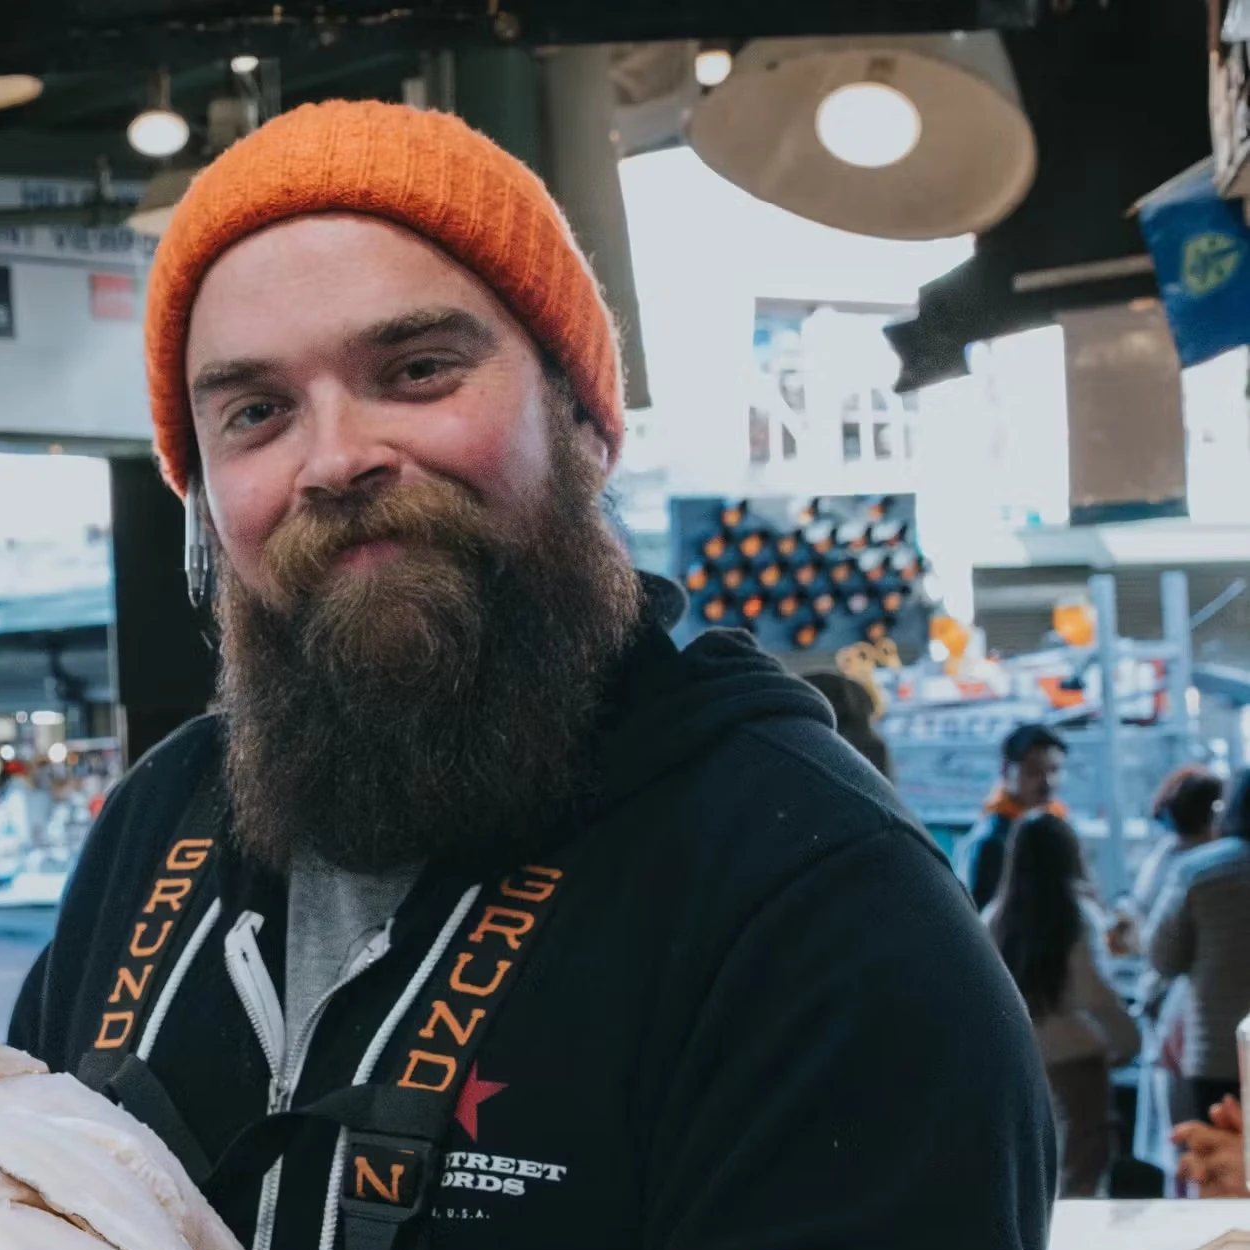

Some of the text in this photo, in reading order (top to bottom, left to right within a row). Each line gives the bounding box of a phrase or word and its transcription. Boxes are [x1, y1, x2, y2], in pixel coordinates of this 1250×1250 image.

[94, 838, 214, 1049] GRUND
[397, 864, 563, 1092] GRUND
[445, 1151, 568, 1182] TREET
[447, 1208, 490, 1219] U.S.A.
